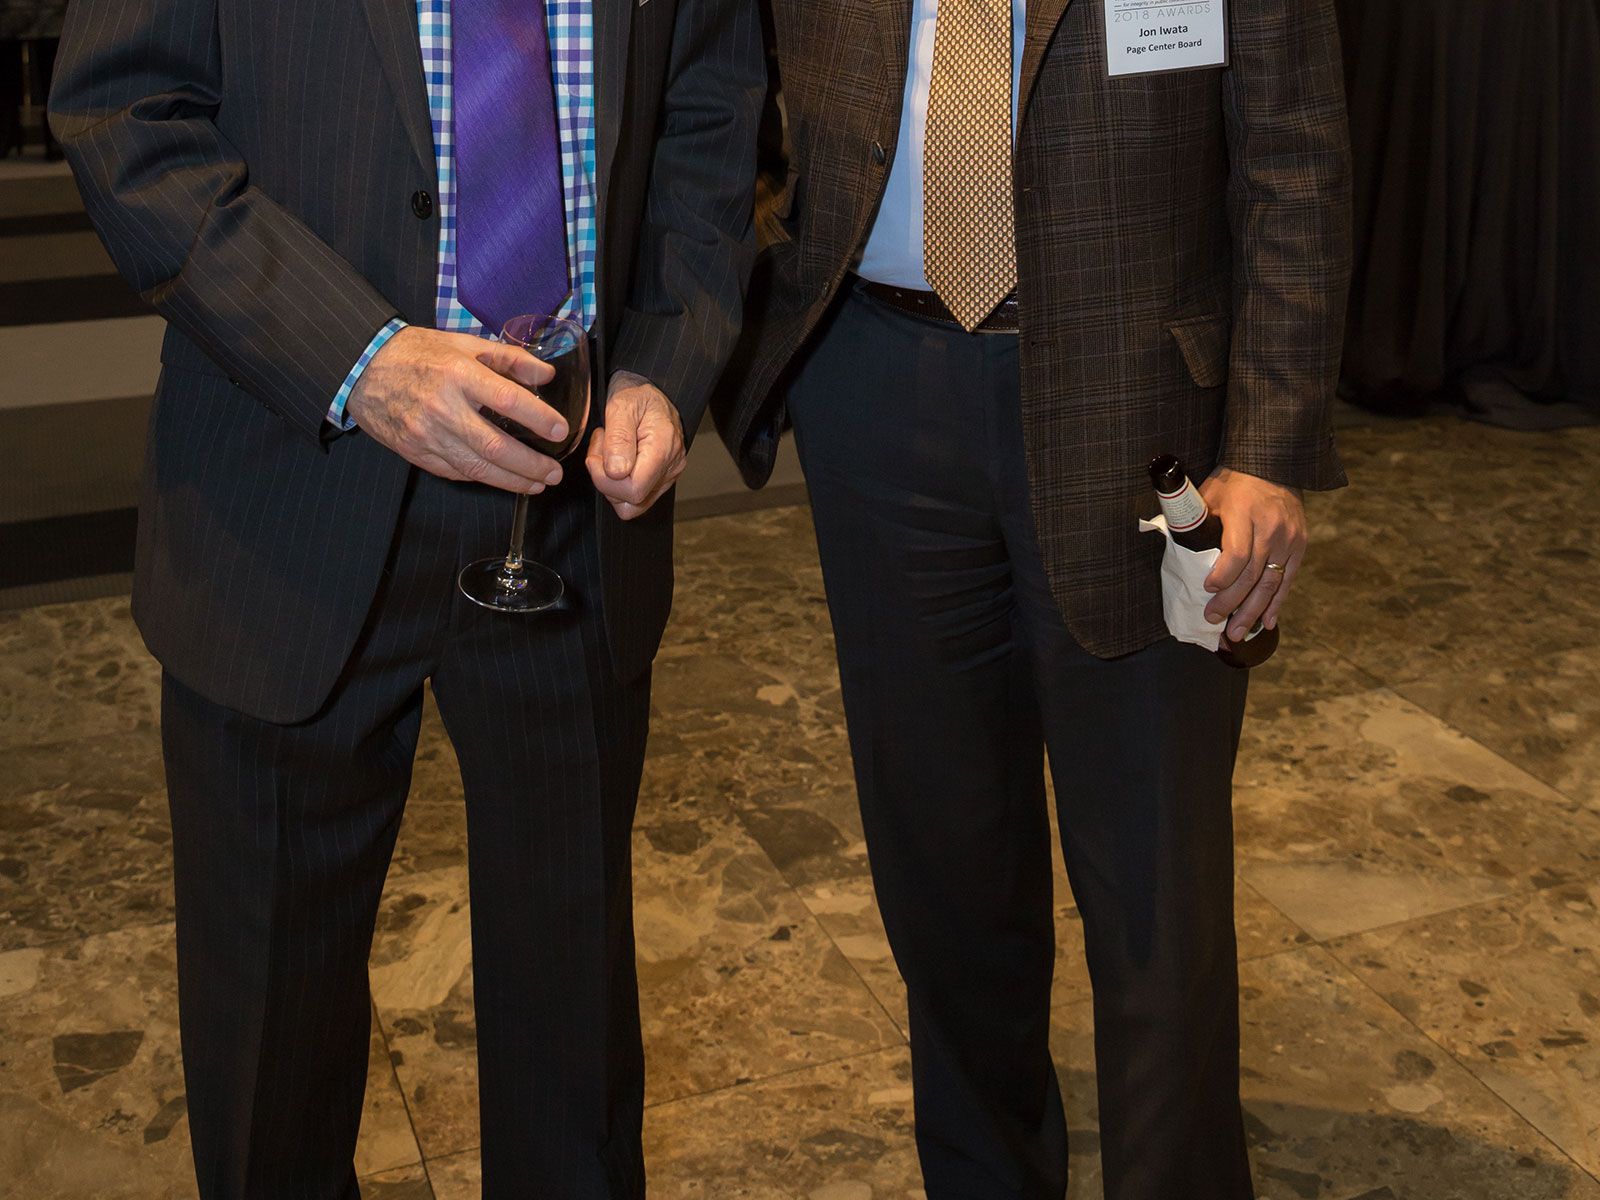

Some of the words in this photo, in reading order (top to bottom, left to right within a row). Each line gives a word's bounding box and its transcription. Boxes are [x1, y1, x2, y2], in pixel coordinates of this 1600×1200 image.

[1114, 10, 1150, 22] 2018
[1157, 4, 1210, 18] AWARDS
[1139, 28, 1156, 38] Jon
[1160, 25, 1188, 35] Iwata
[1127, 46, 1146, 54] Page
[1148, 43, 1176, 52] Center
[1178, 39, 1202, 49] Board
